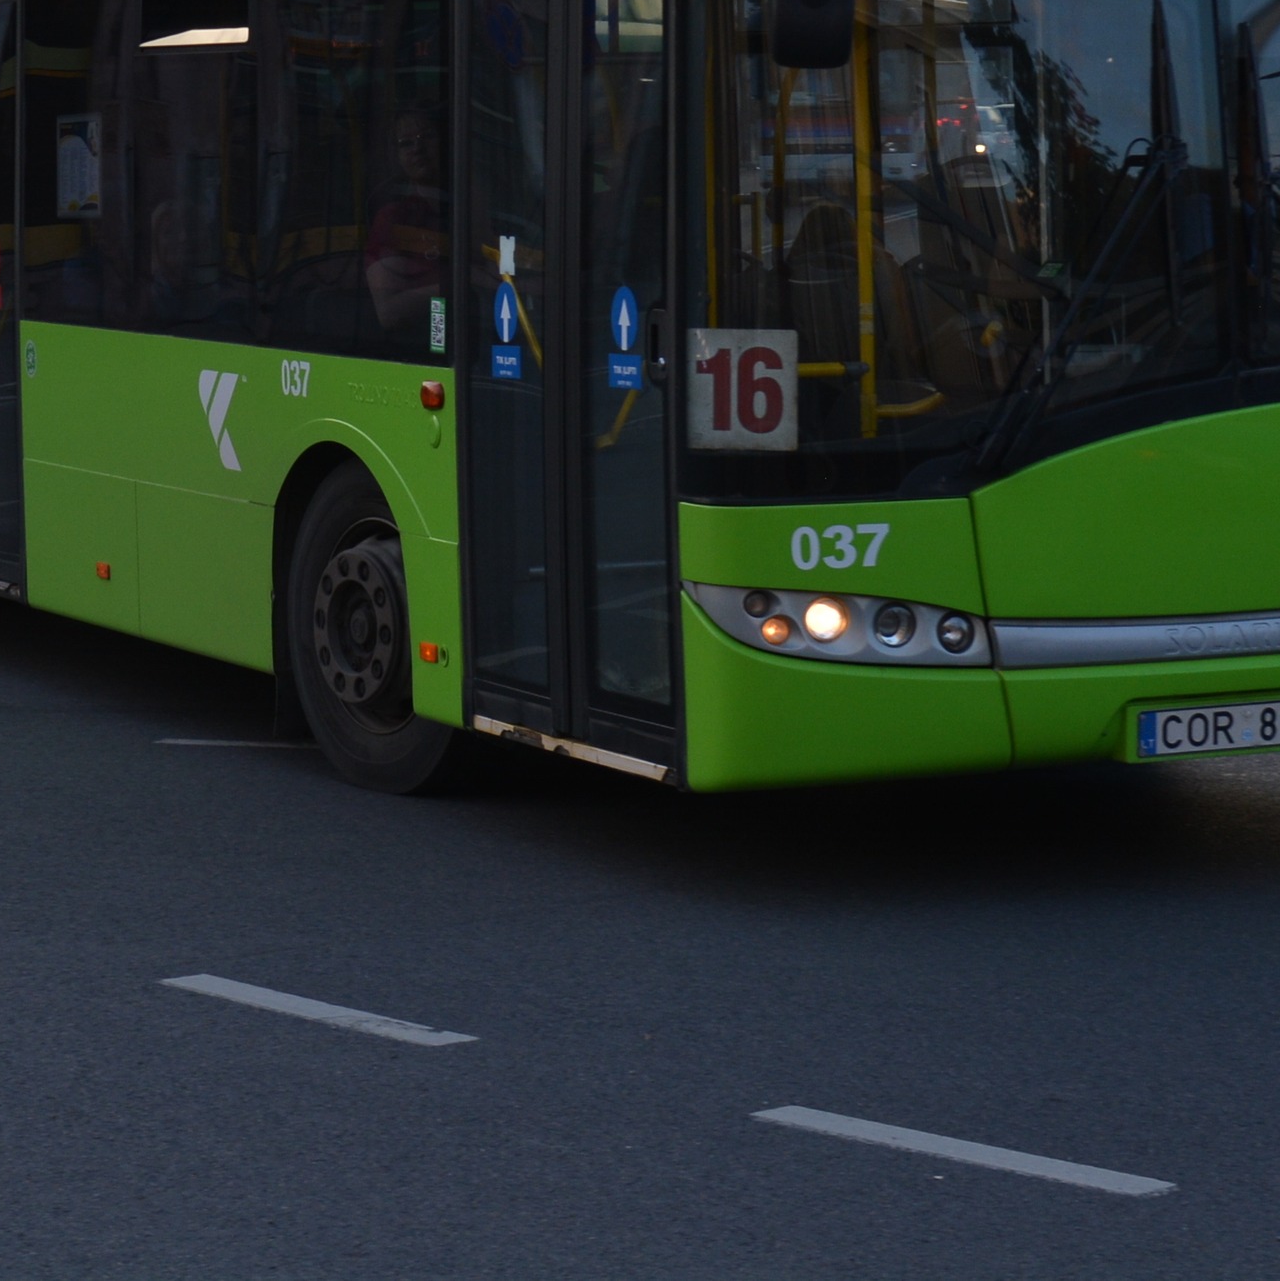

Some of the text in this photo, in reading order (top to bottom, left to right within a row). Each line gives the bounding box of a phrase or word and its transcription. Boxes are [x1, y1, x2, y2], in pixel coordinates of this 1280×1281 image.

[281, 359, 311, 398] 037
[696, 346, 784, 434] 16
[790, 523, 890, 570] 037
[1140, 738, 1156, 750] LT
[1162, 710, 1234, 749] COR
